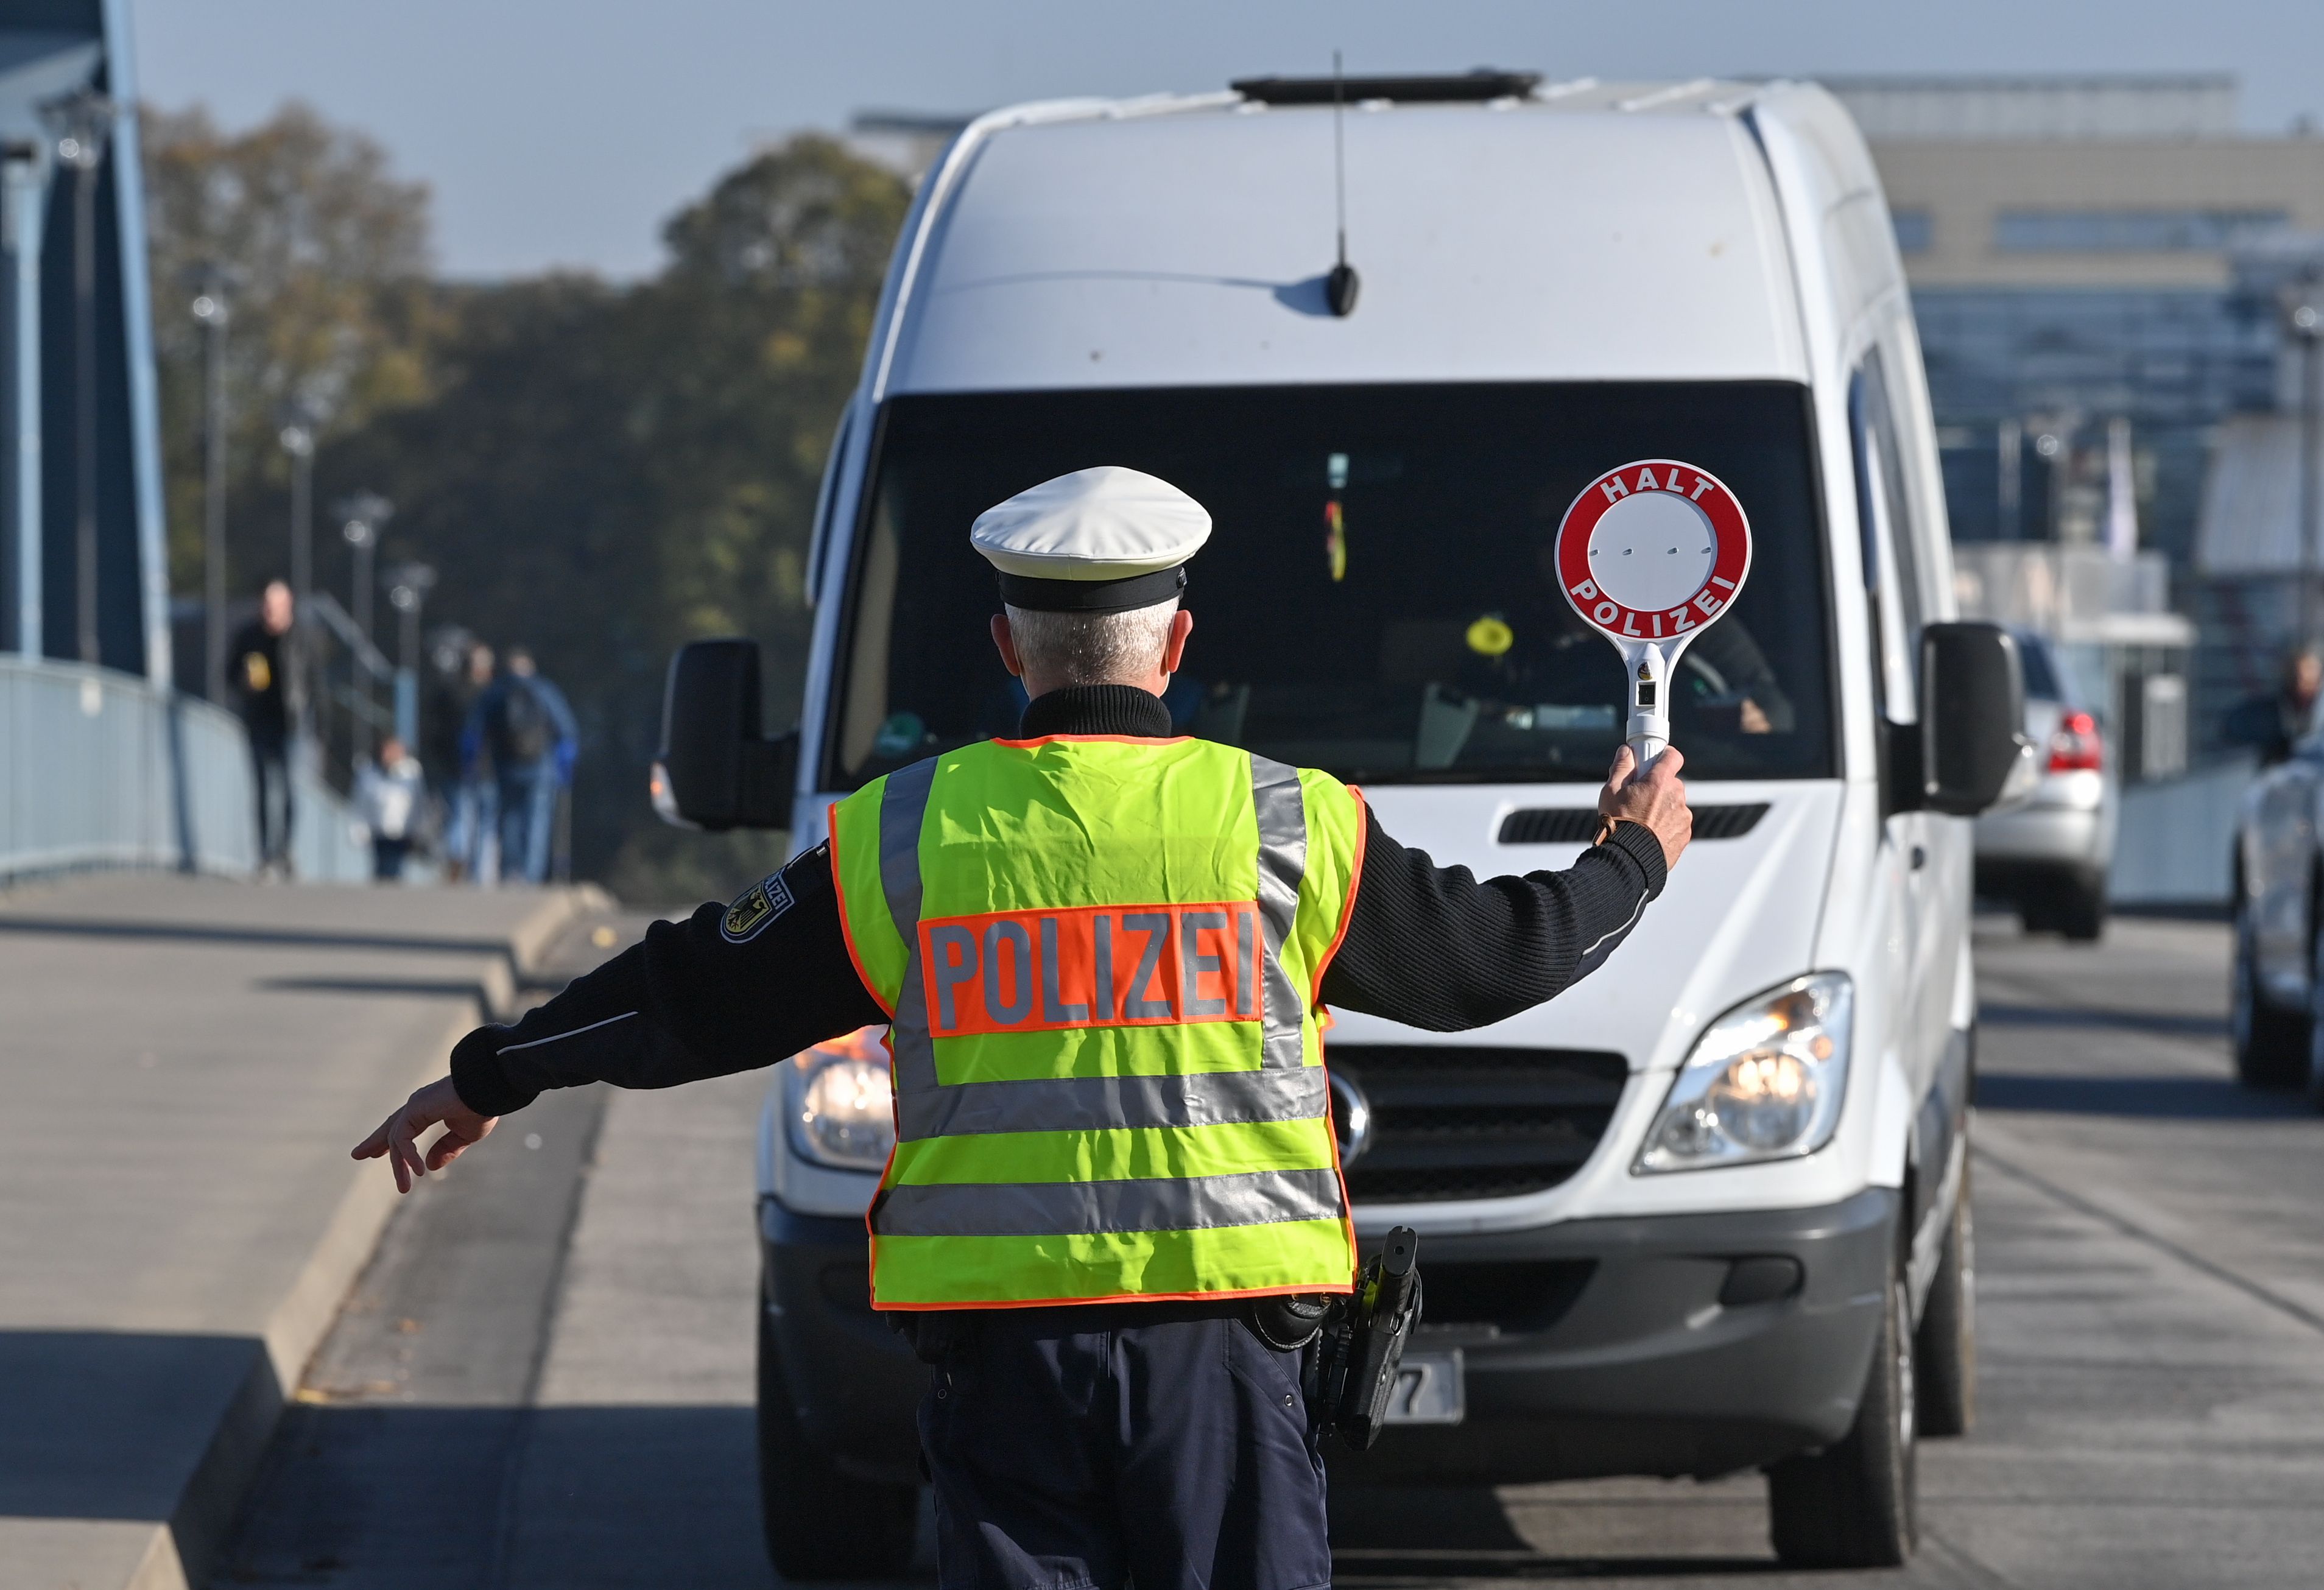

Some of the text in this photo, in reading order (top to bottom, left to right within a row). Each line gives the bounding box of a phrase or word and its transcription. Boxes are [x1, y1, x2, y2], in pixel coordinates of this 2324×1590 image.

[1600, 468, 1715, 503] HALT
[1570, 575, 1736, 637] POLIZEI
[764, 871, 788, 910] LIZEI
[930, 912, 1253, 1029] POLIZEI
